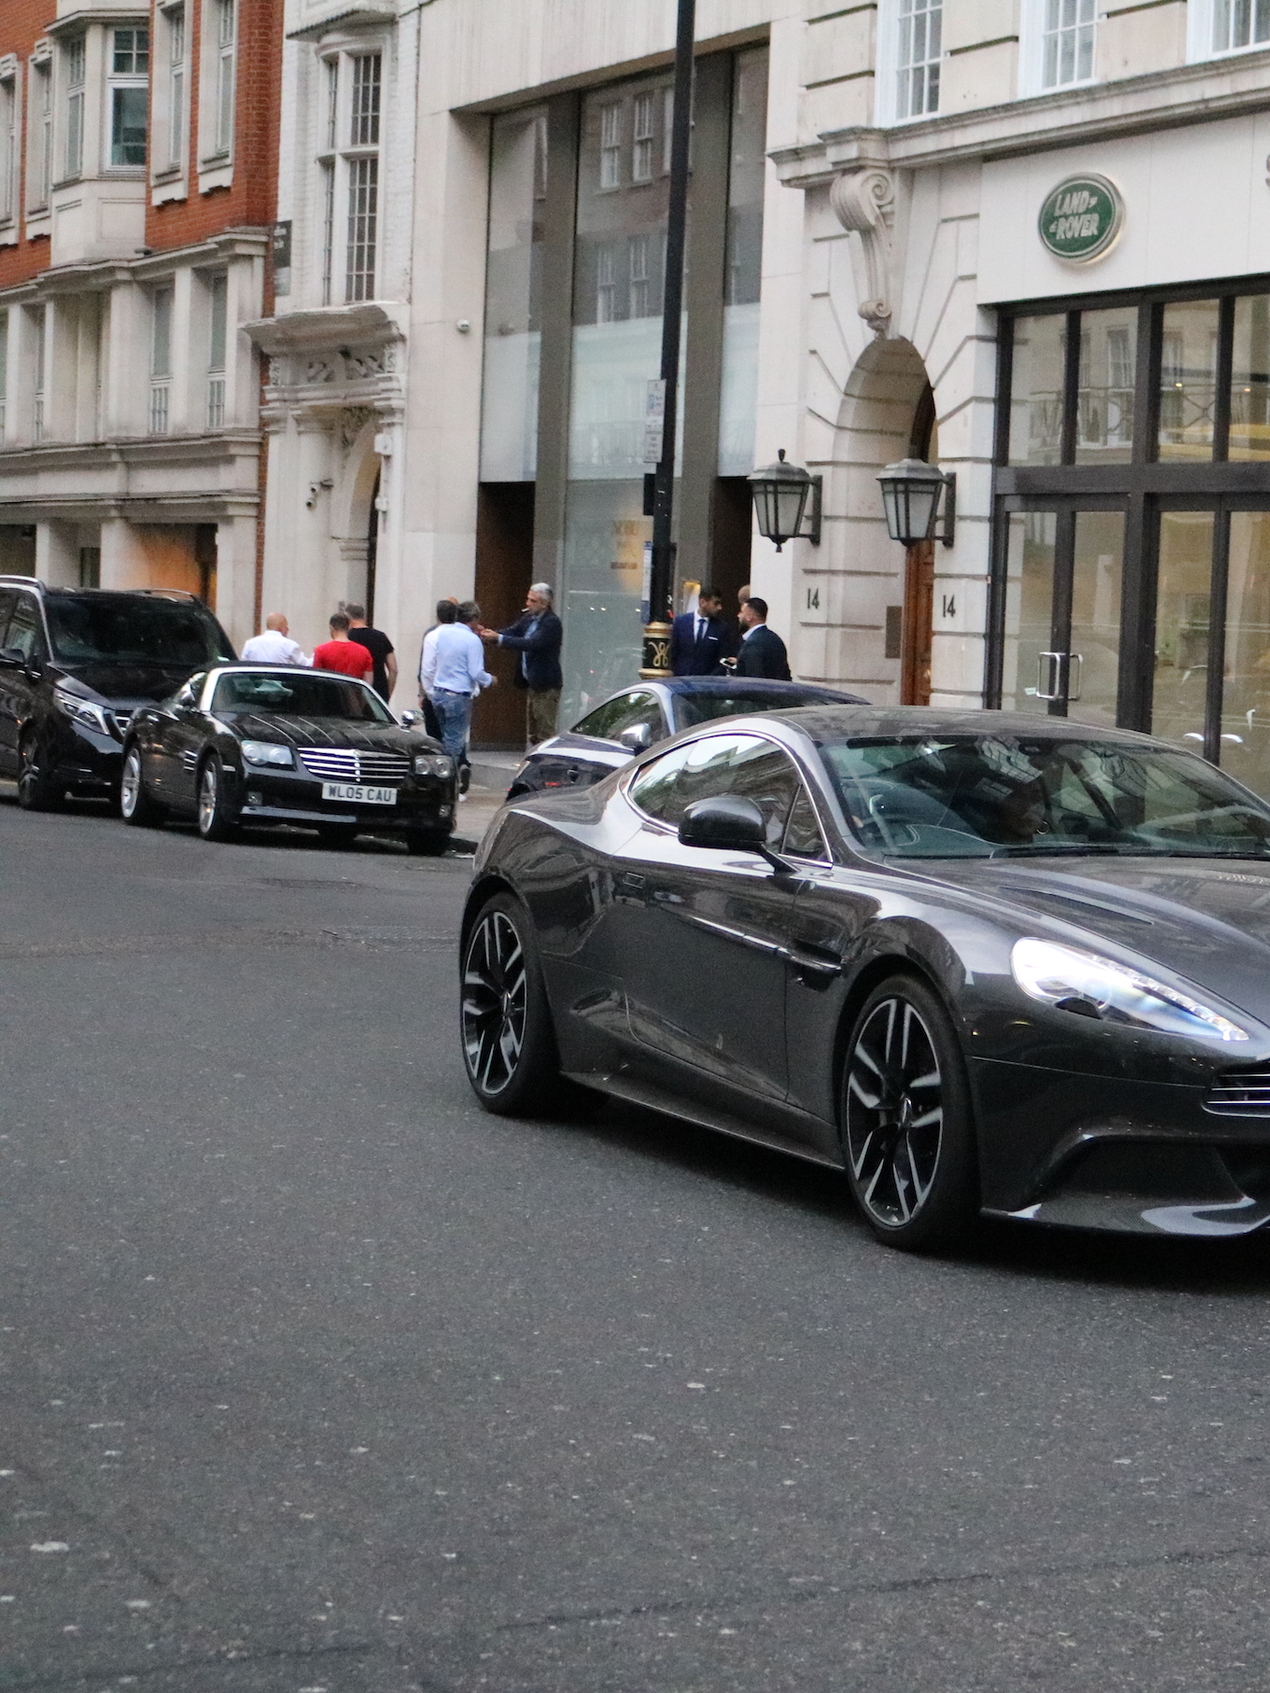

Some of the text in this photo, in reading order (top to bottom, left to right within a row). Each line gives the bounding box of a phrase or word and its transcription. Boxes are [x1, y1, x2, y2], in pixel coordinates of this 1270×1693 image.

[1053, 190, 1090, 217] LAND
[1056, 213, 1100, 240] ROVER
[807, 588, 820, 610] 14
[942, 594, 956, 618] 14
[329, 785, 392, 802] WL05 CAU
